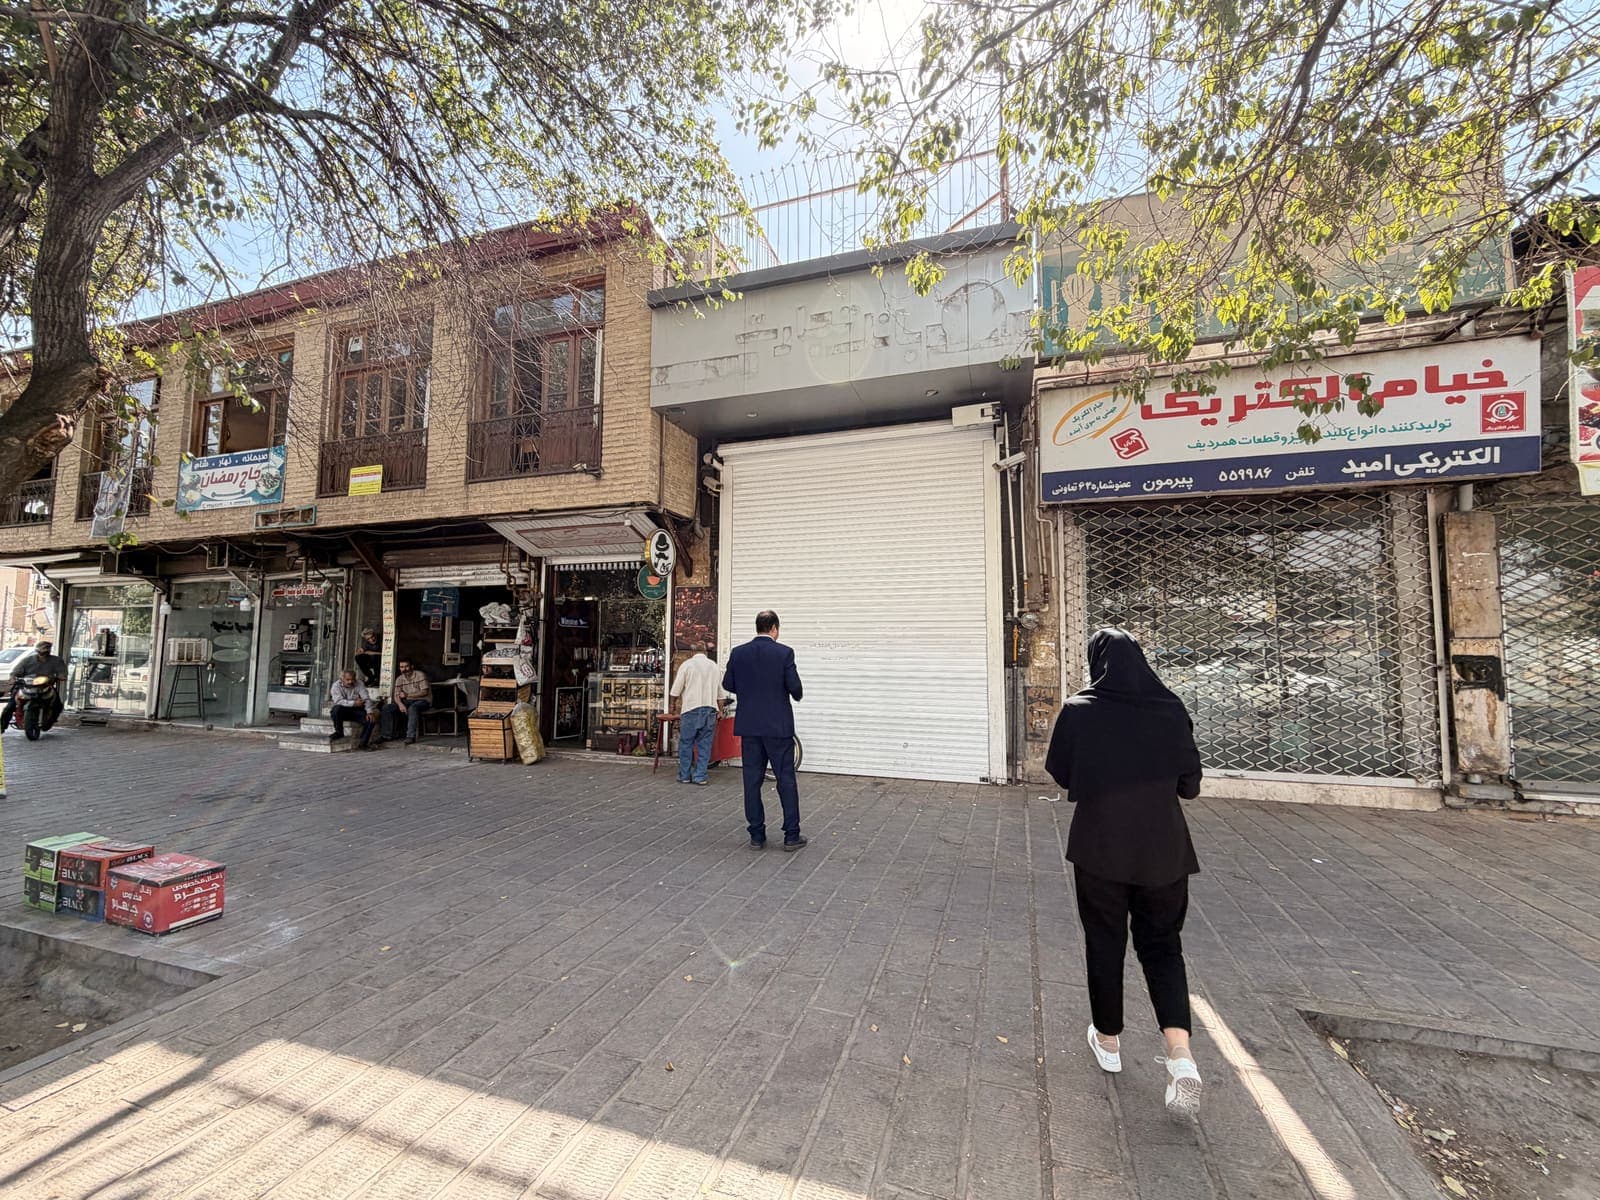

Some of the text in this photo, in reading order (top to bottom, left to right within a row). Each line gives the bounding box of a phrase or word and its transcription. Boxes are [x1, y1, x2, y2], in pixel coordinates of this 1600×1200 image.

[1371, 359, 1508, 408] خیام
[1238, 432, 1280, 445] قطعات
[1323, 427, 1349, 441] کلید
[1347, 424, 1378, 441] انواع
[1341, 446, 1501, 478] الکتریکی امید
[200, 467, 261, 489] حاج رمضان
[1218, 466, 1316, 482] تلفن ۵۵۹۹۸۶
[1052, 482, 1078, 495] تعاونی
[1142, 475, 1194, 492] پیرمون
